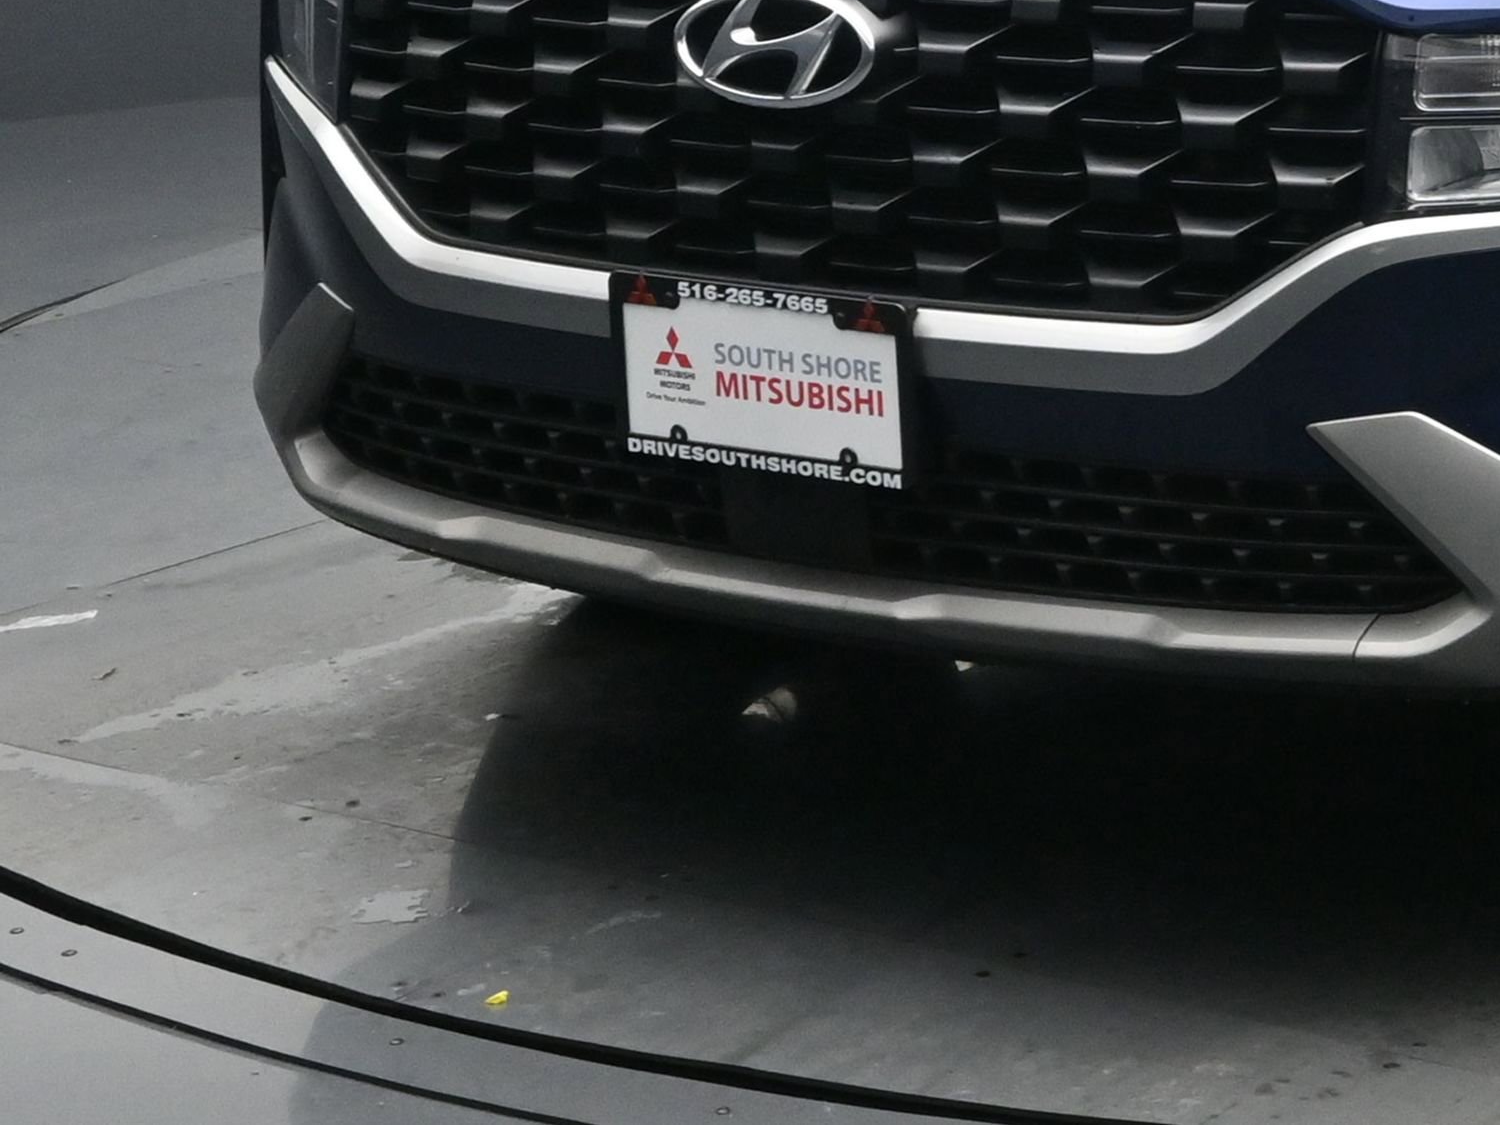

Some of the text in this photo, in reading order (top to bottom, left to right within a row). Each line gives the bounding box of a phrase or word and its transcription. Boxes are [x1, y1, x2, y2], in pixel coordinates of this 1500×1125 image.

[677, 281, 829, 314] 516-265-7665
[653, 368, 696, 380] MITSUBISHI
[714, 342, 882, 383] SOUTH SHORE
[659, 380, 691, 391] MOTORS
[715, 370, 884, 417] MITSUBISHI
[627, 436, 902, 490] DRIVESOUTHSHORE.COM
